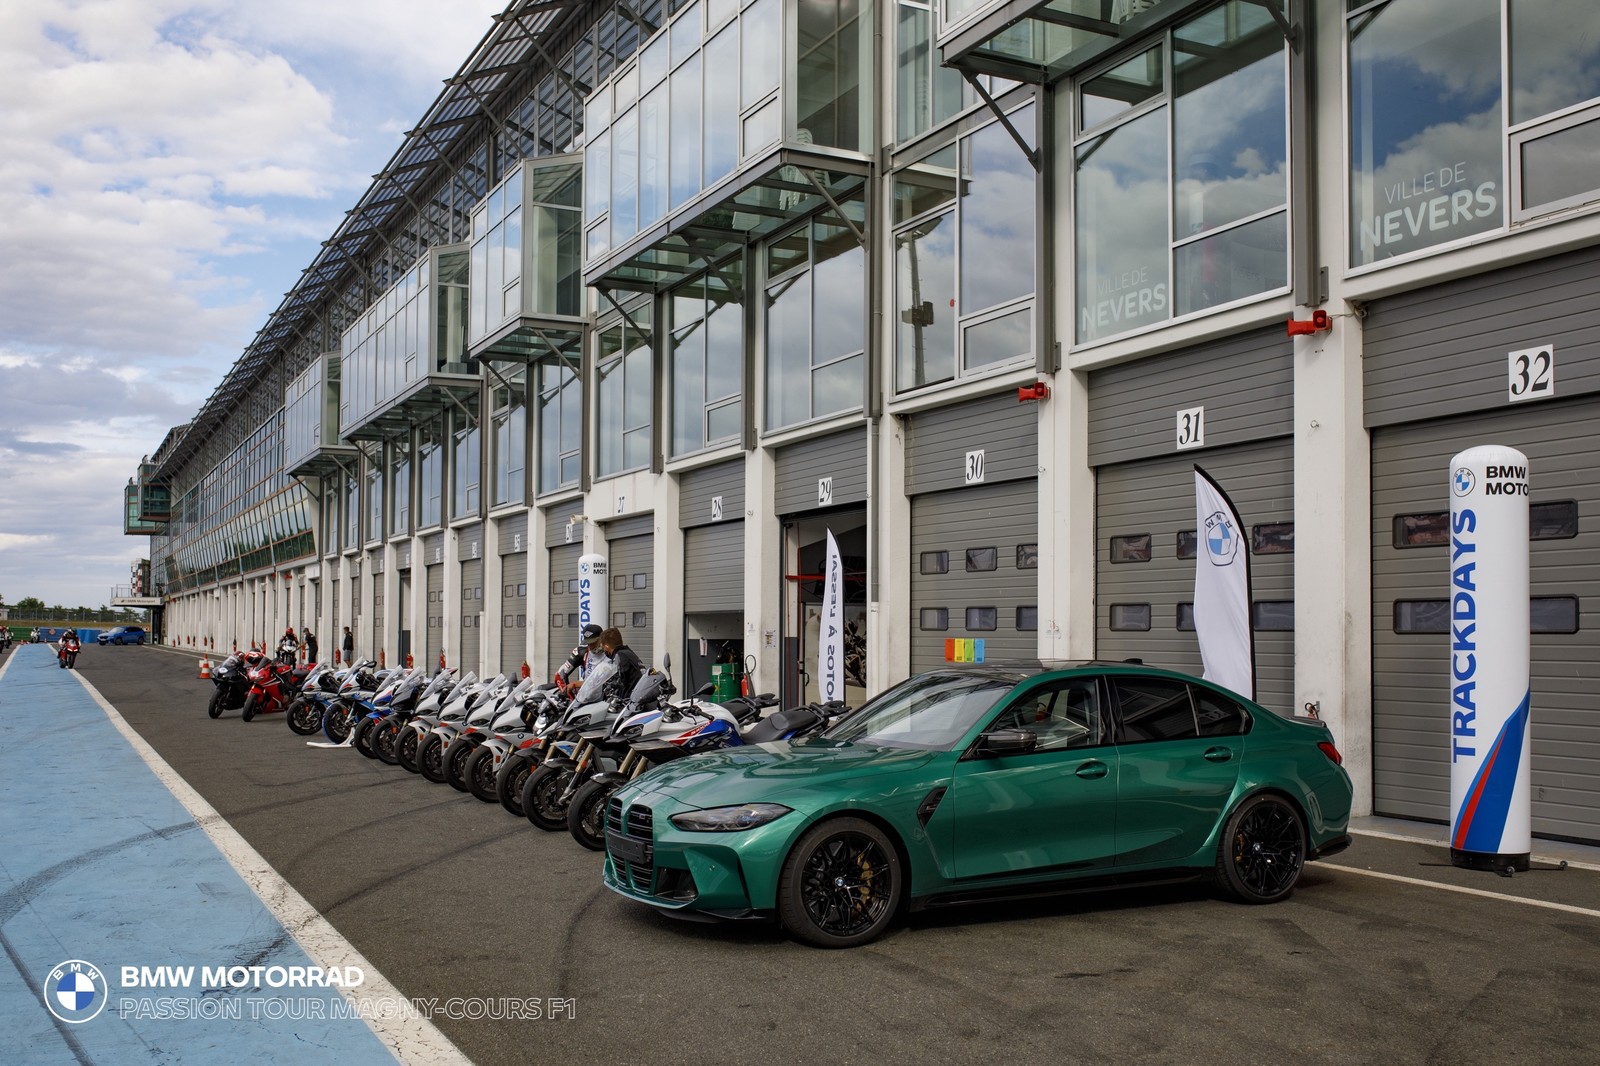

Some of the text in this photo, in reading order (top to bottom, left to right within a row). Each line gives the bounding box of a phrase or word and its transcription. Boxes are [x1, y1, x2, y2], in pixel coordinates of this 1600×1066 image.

[1384, 161, 1466, 204] VILLE DE
[1360, 181, 1497, 251] NEVERS
[1098, 266, 1149, 295] VILLE DE
[1082, 283, 1167, 332] NEVERS
[1511, 350, 1550, 395] 32
[1179, 411, 1201, 445] 31
[966, 453, 984, 481] 30
[1486, 465, 1526, 479] BMW
[617, 496, 625, 513] 27
[819, 480, 832, 503] 29
[712, 499, 722, 518] 28
[1452, 508, 1477, 764] TRACKDAYS
